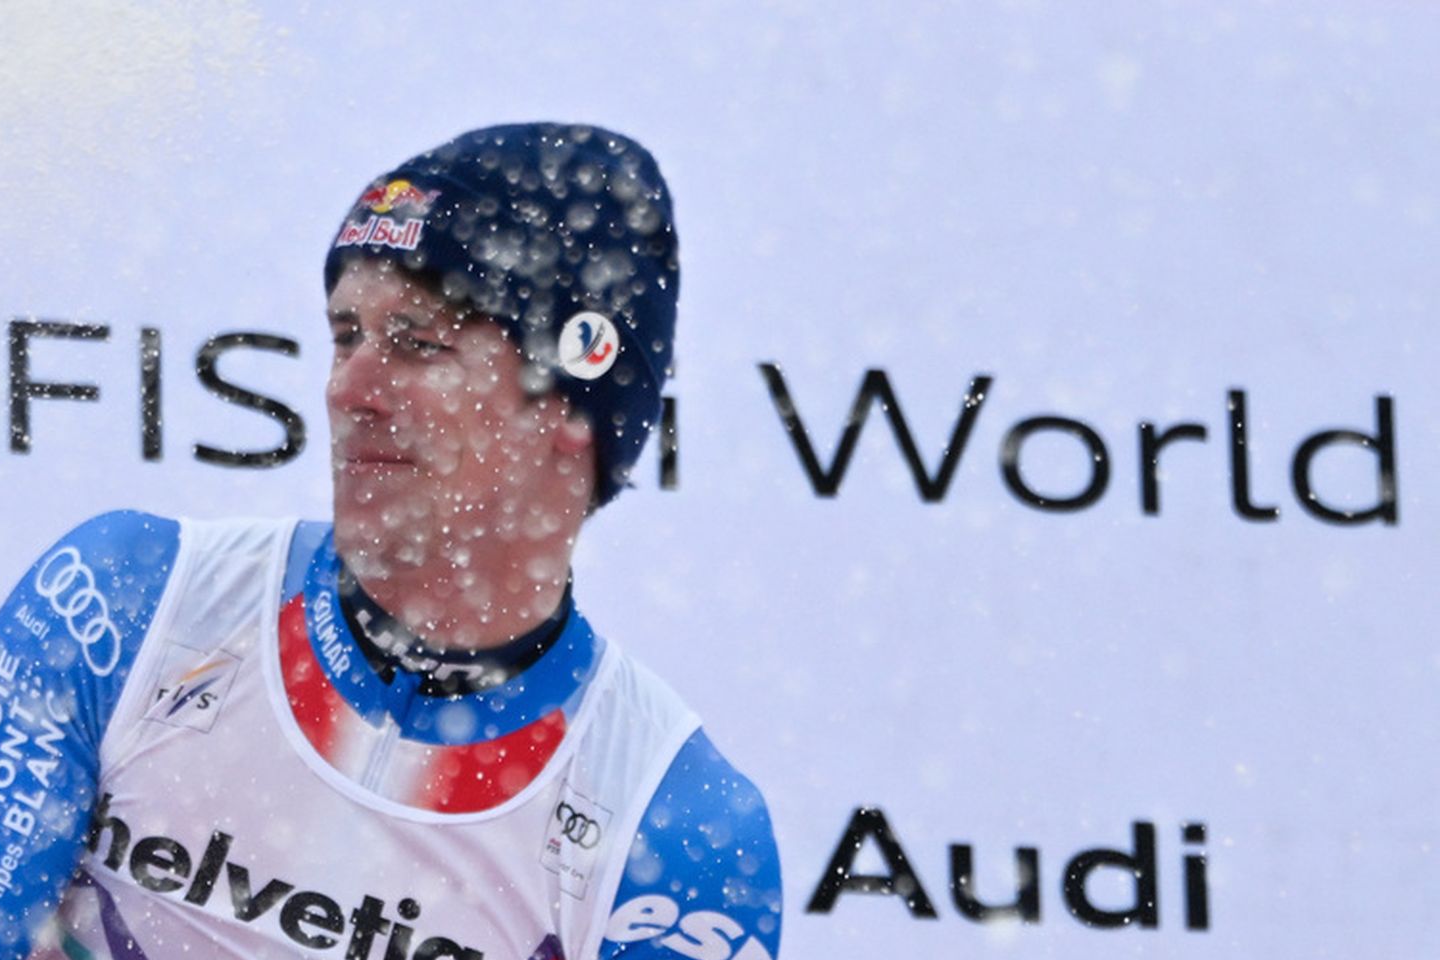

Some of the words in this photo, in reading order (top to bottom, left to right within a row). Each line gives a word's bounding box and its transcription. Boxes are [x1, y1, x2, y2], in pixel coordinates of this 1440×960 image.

[368, 218, 423, 250] Bull
[9, 319, 307, 469] FIS
[756, 361, 1398, 527] World
[15, 604, 51, 640] Audi
[313, 590, 352, 679] COLMAR
[3, 690, 70, 837] BLANC
[803, 806, 1211, 932] Audi
